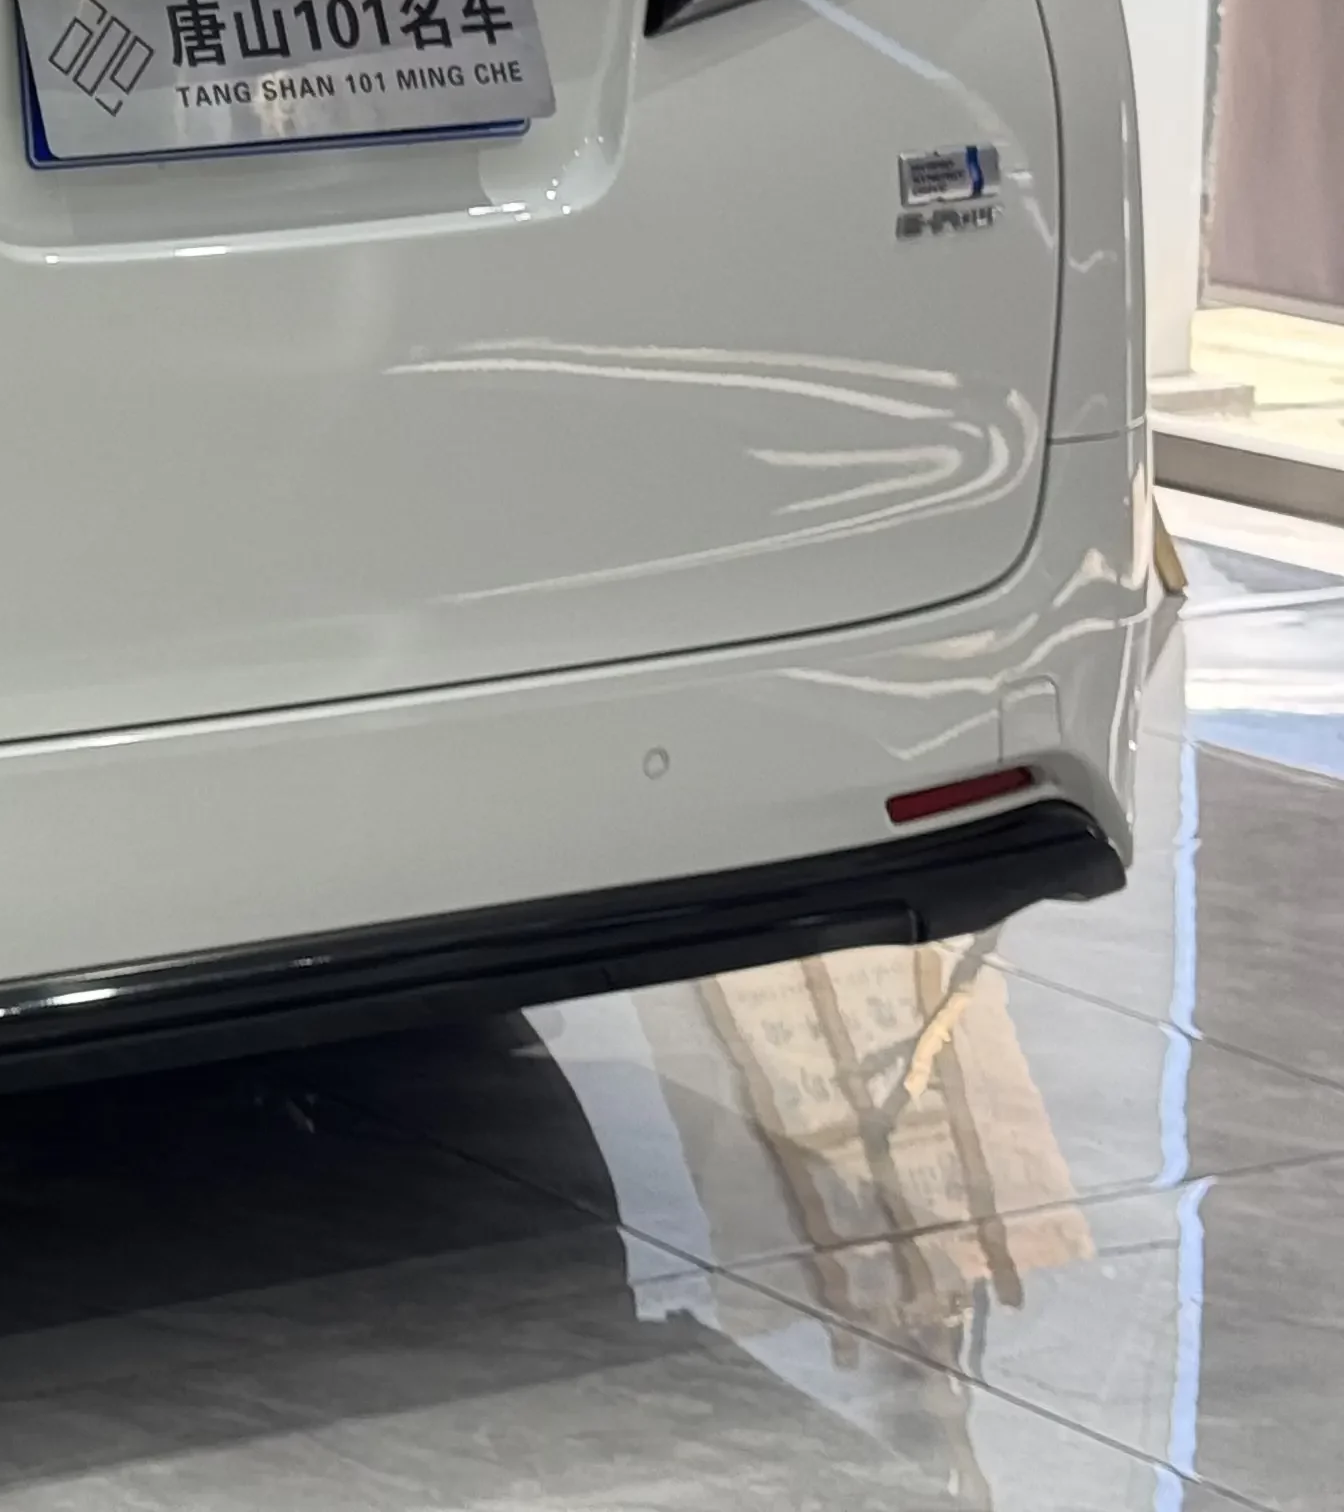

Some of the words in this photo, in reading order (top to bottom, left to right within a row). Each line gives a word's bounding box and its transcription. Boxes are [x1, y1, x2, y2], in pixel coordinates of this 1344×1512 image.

[175, 81, 252, 108] TANG
[263, 74, 335, 102] SHAN
[345, 72, 386, 94] 101
[396, 65, 465, 90] MING
[474, 60, 523, 85] CHE
